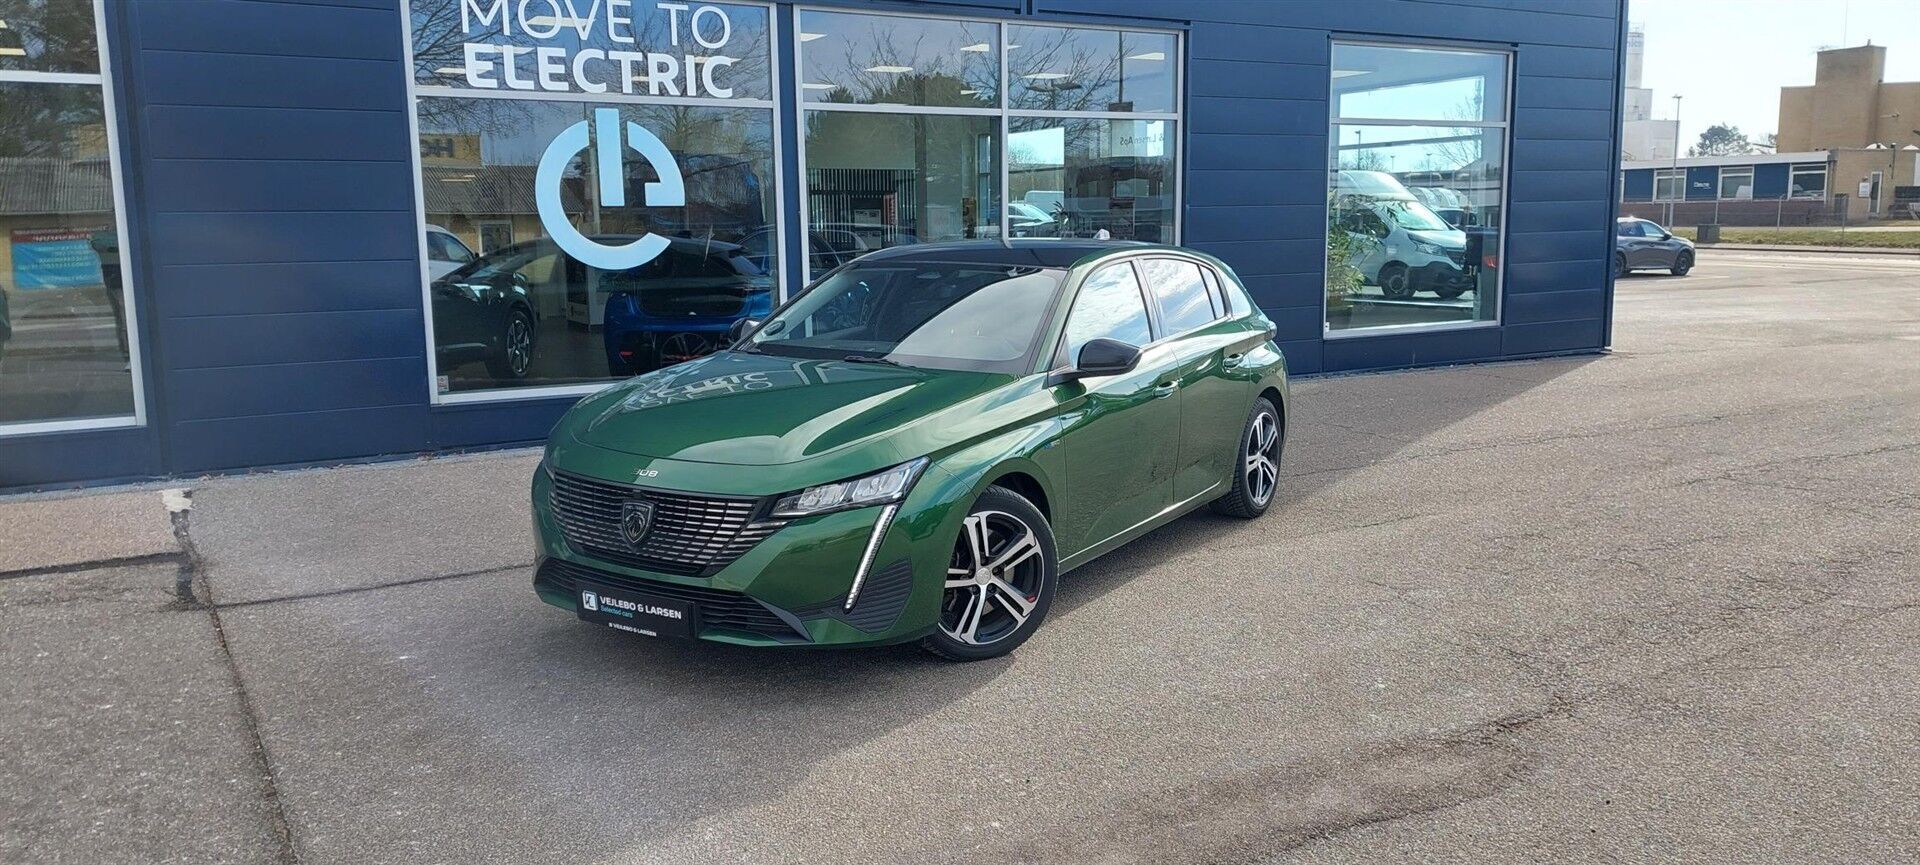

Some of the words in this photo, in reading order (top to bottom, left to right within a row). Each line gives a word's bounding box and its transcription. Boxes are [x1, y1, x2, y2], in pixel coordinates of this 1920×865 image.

[462, 0, 634, 43] MOVE
[657, 3, 731, 49] TO
[463, 42, 733, 98] ELECTRIC
[600, 596, 636, 611] VEJLEBO
[637, 603, 644, 612] &
[645, 605, 682, 619] LARSEN
[621, 610, 633, 618] cars
[613, 623, 633, 632] VEJLEBO
[637, 628, 657, 637] LARSEN
